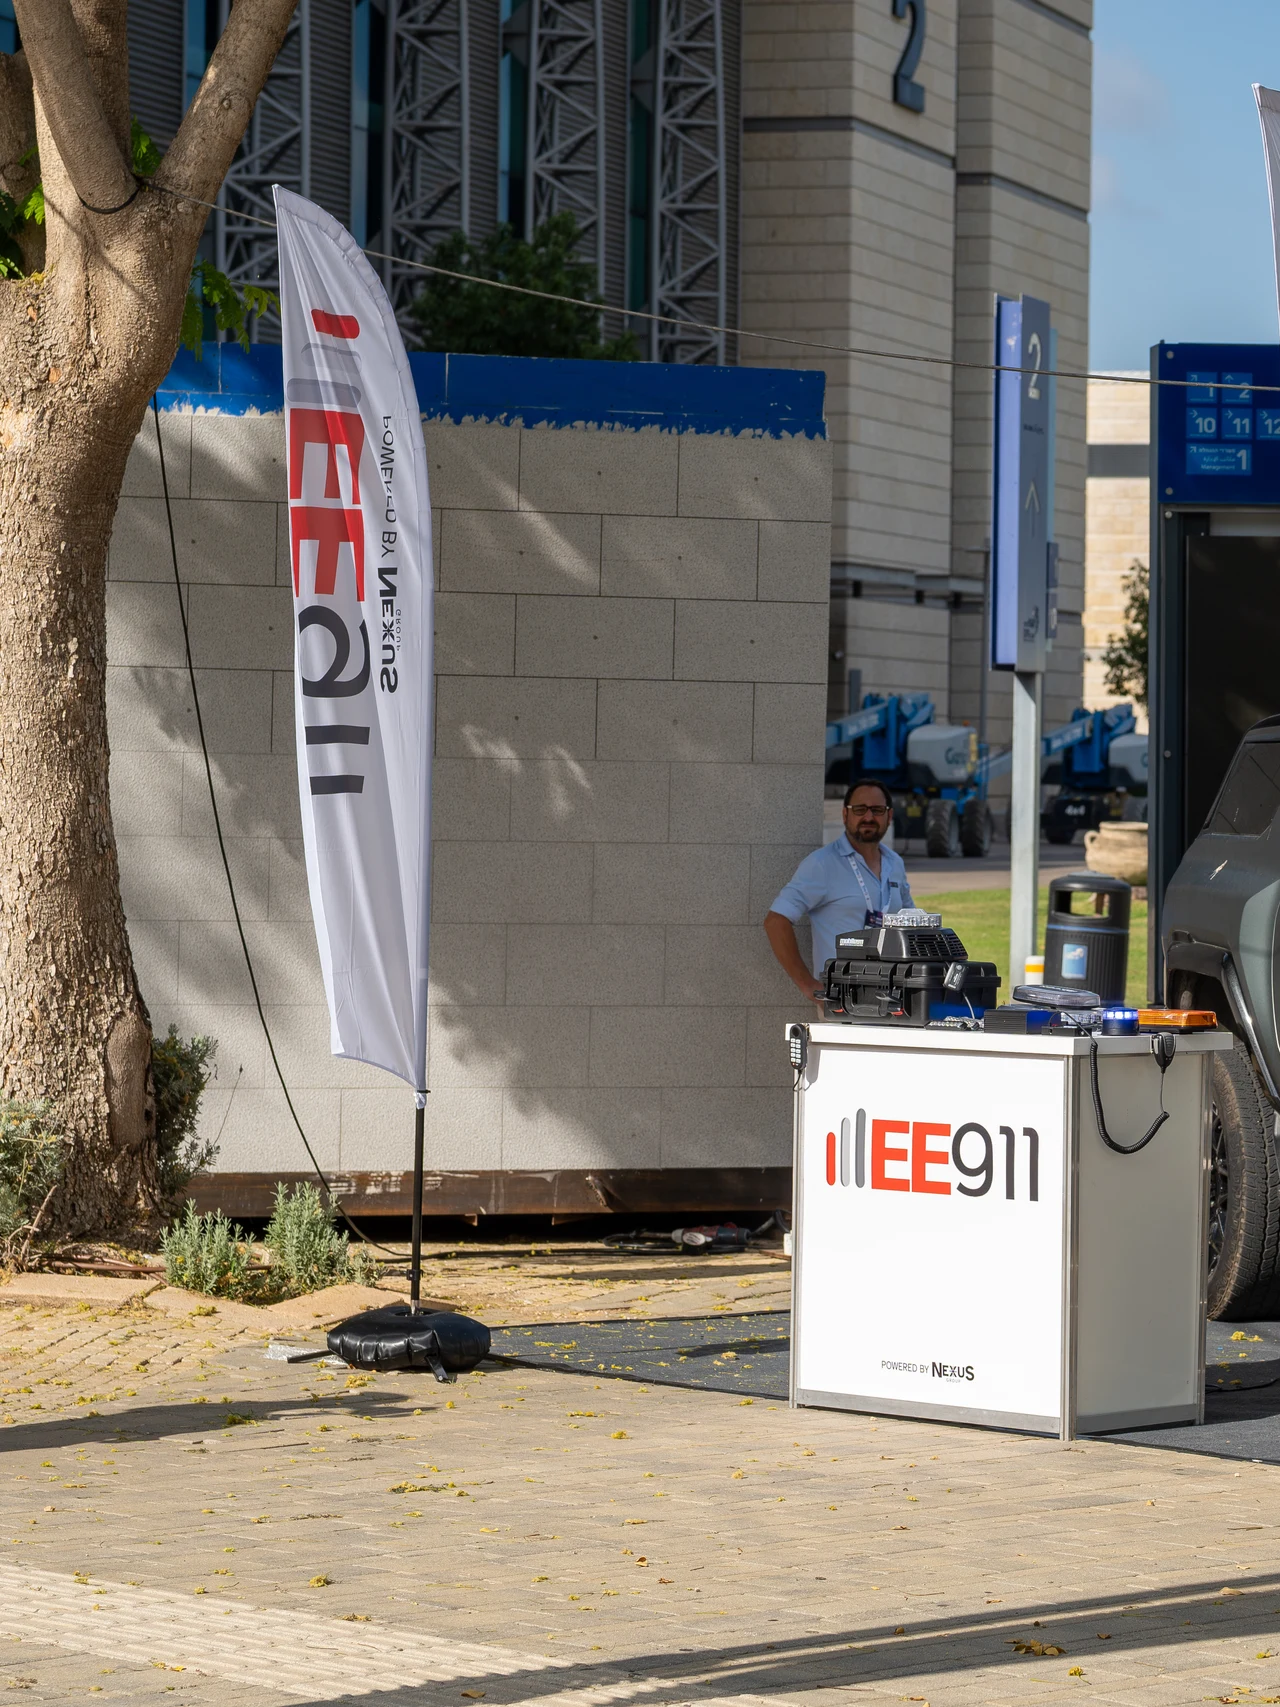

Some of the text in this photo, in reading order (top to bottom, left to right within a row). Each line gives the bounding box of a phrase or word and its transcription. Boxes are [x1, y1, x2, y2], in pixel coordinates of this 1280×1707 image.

[892, 0, 925, 113] 2
[1028, 332, 1041, 400] 2
[1239, 382, 1250, 399] 2
[1195, 417, 1216, 434] 10
[1233, 418, 1250, 434] 11
[1237, 449, 1248, 470] 1
[871, 1119, 1039, 1202] EE911
[881, 1360, 975, 1382] POWERED BY NEXUS
